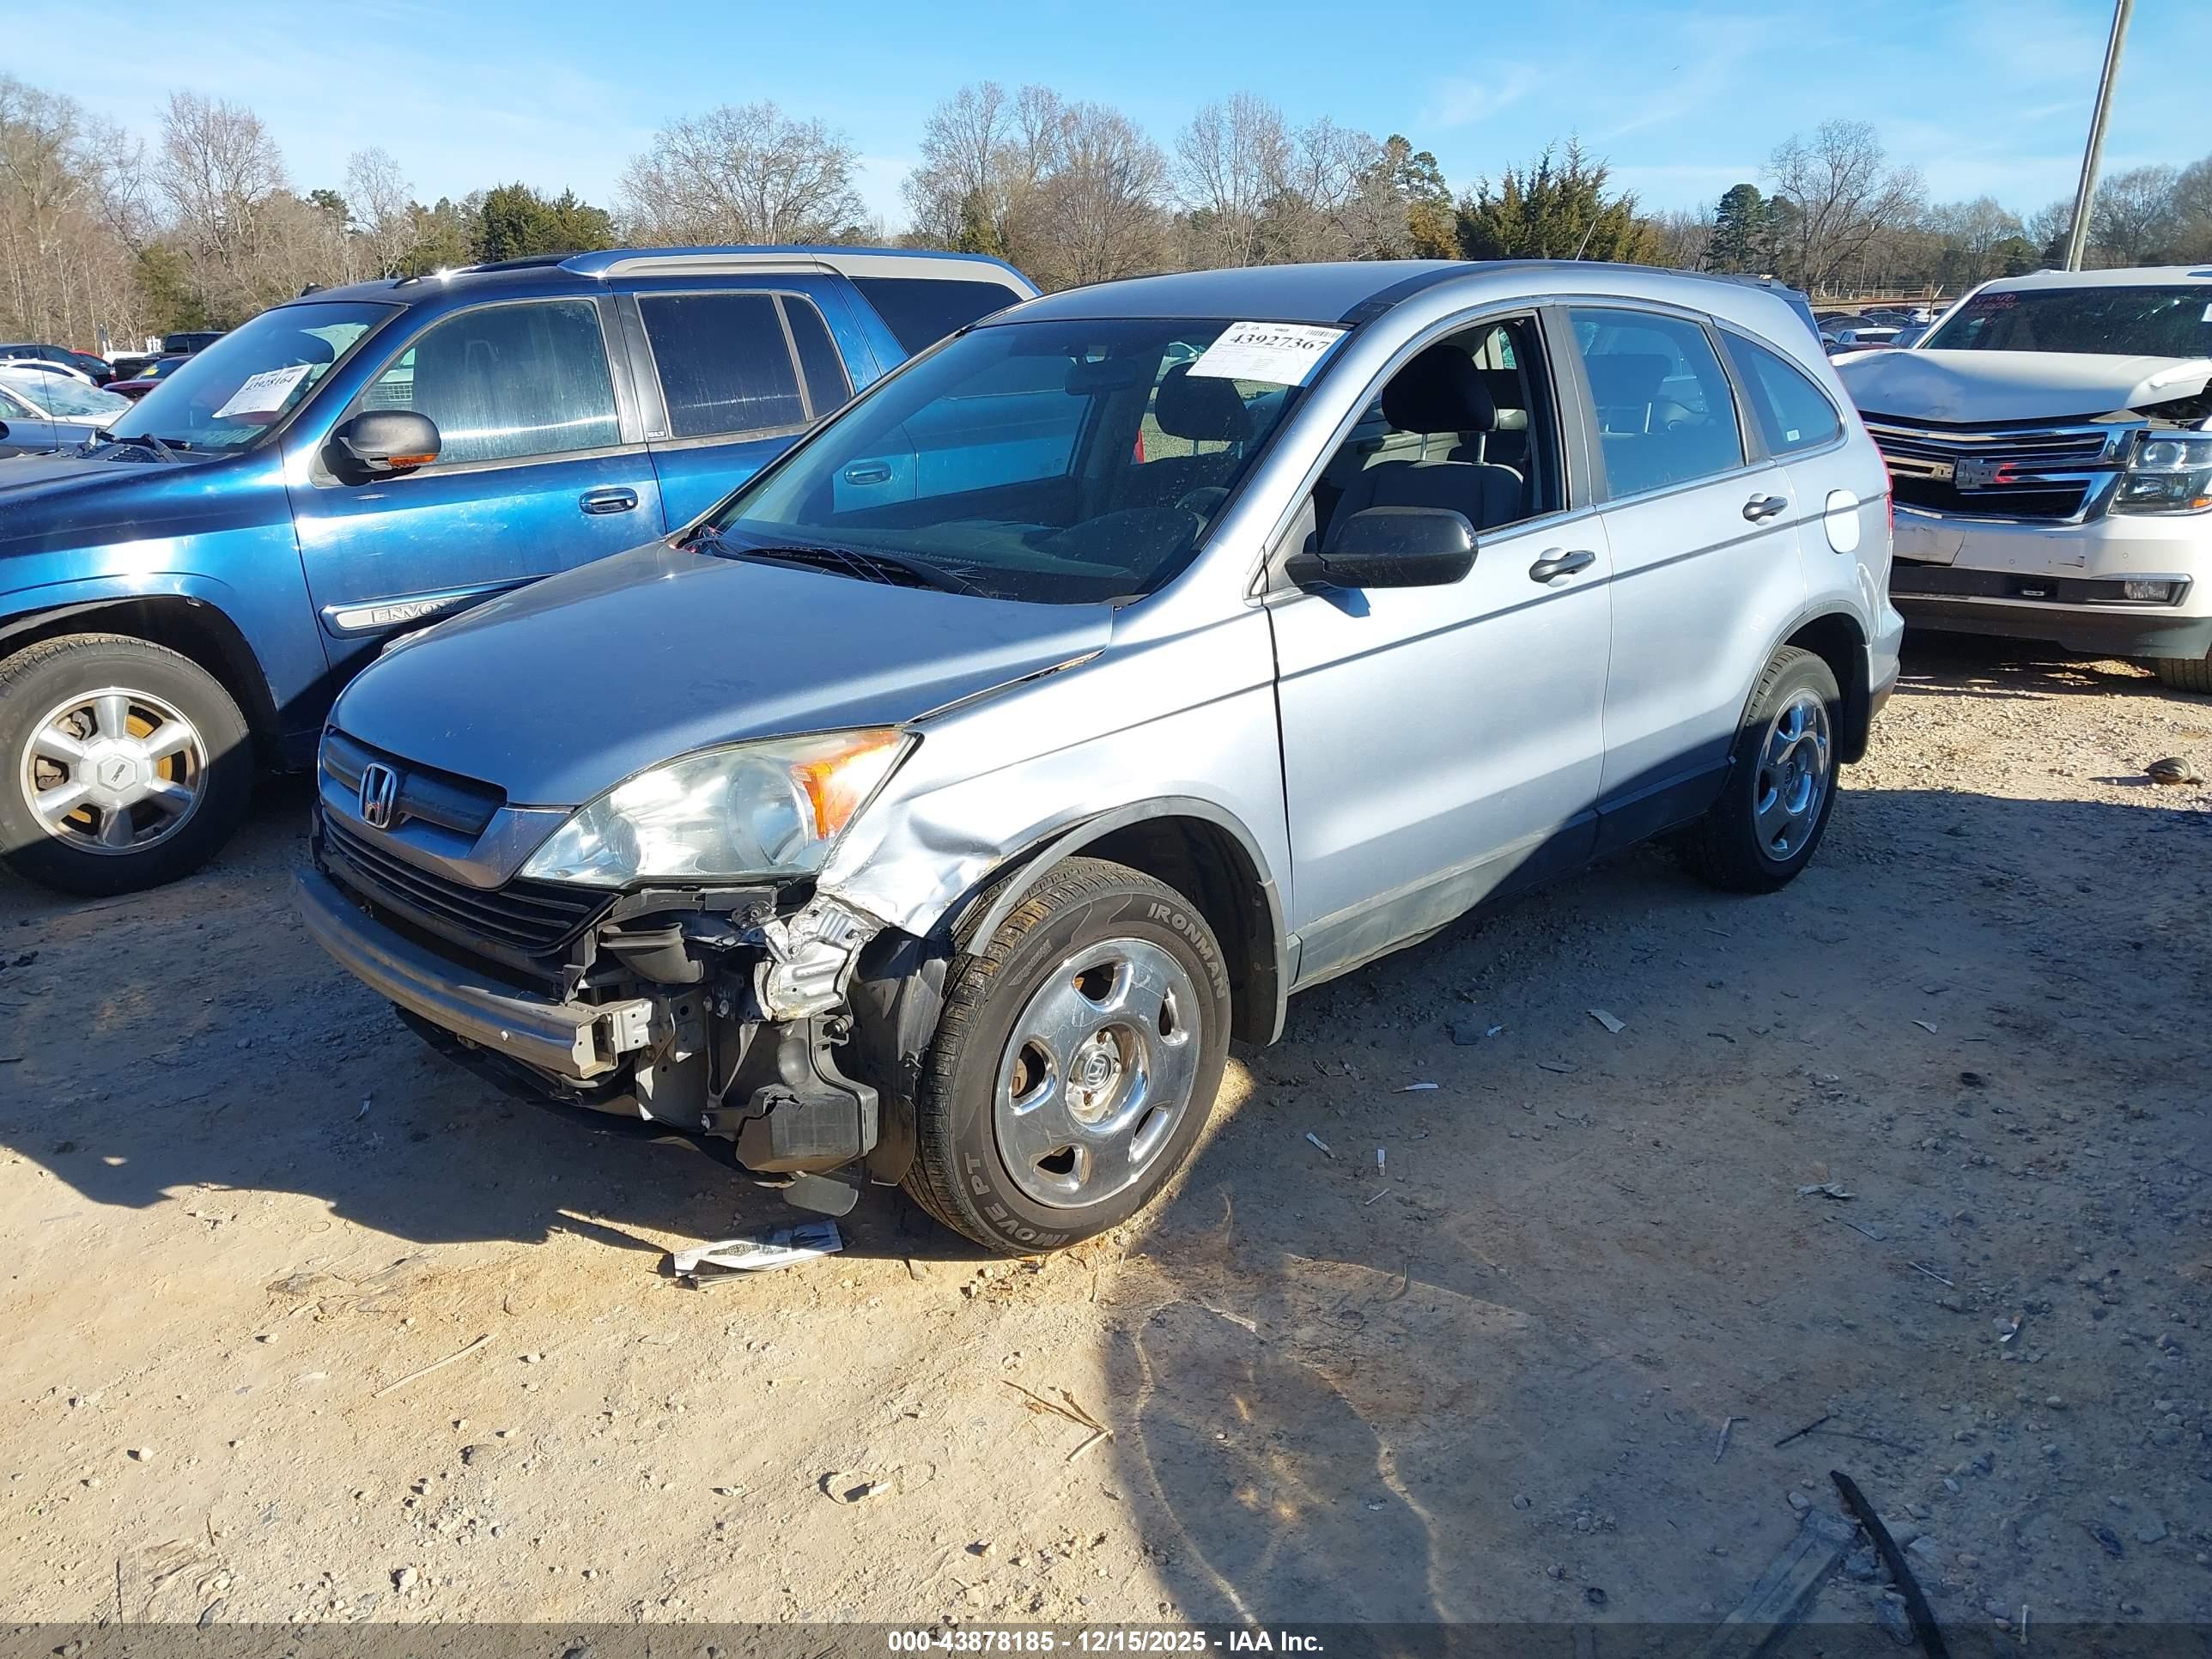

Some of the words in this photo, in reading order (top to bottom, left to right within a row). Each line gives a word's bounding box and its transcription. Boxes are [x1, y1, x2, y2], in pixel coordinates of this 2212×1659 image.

[1229, 333, 1331, 351] 43927367
[1147, 902, 1226, 999] IRONMAN
[964, 1152, 990, 1195] PT
